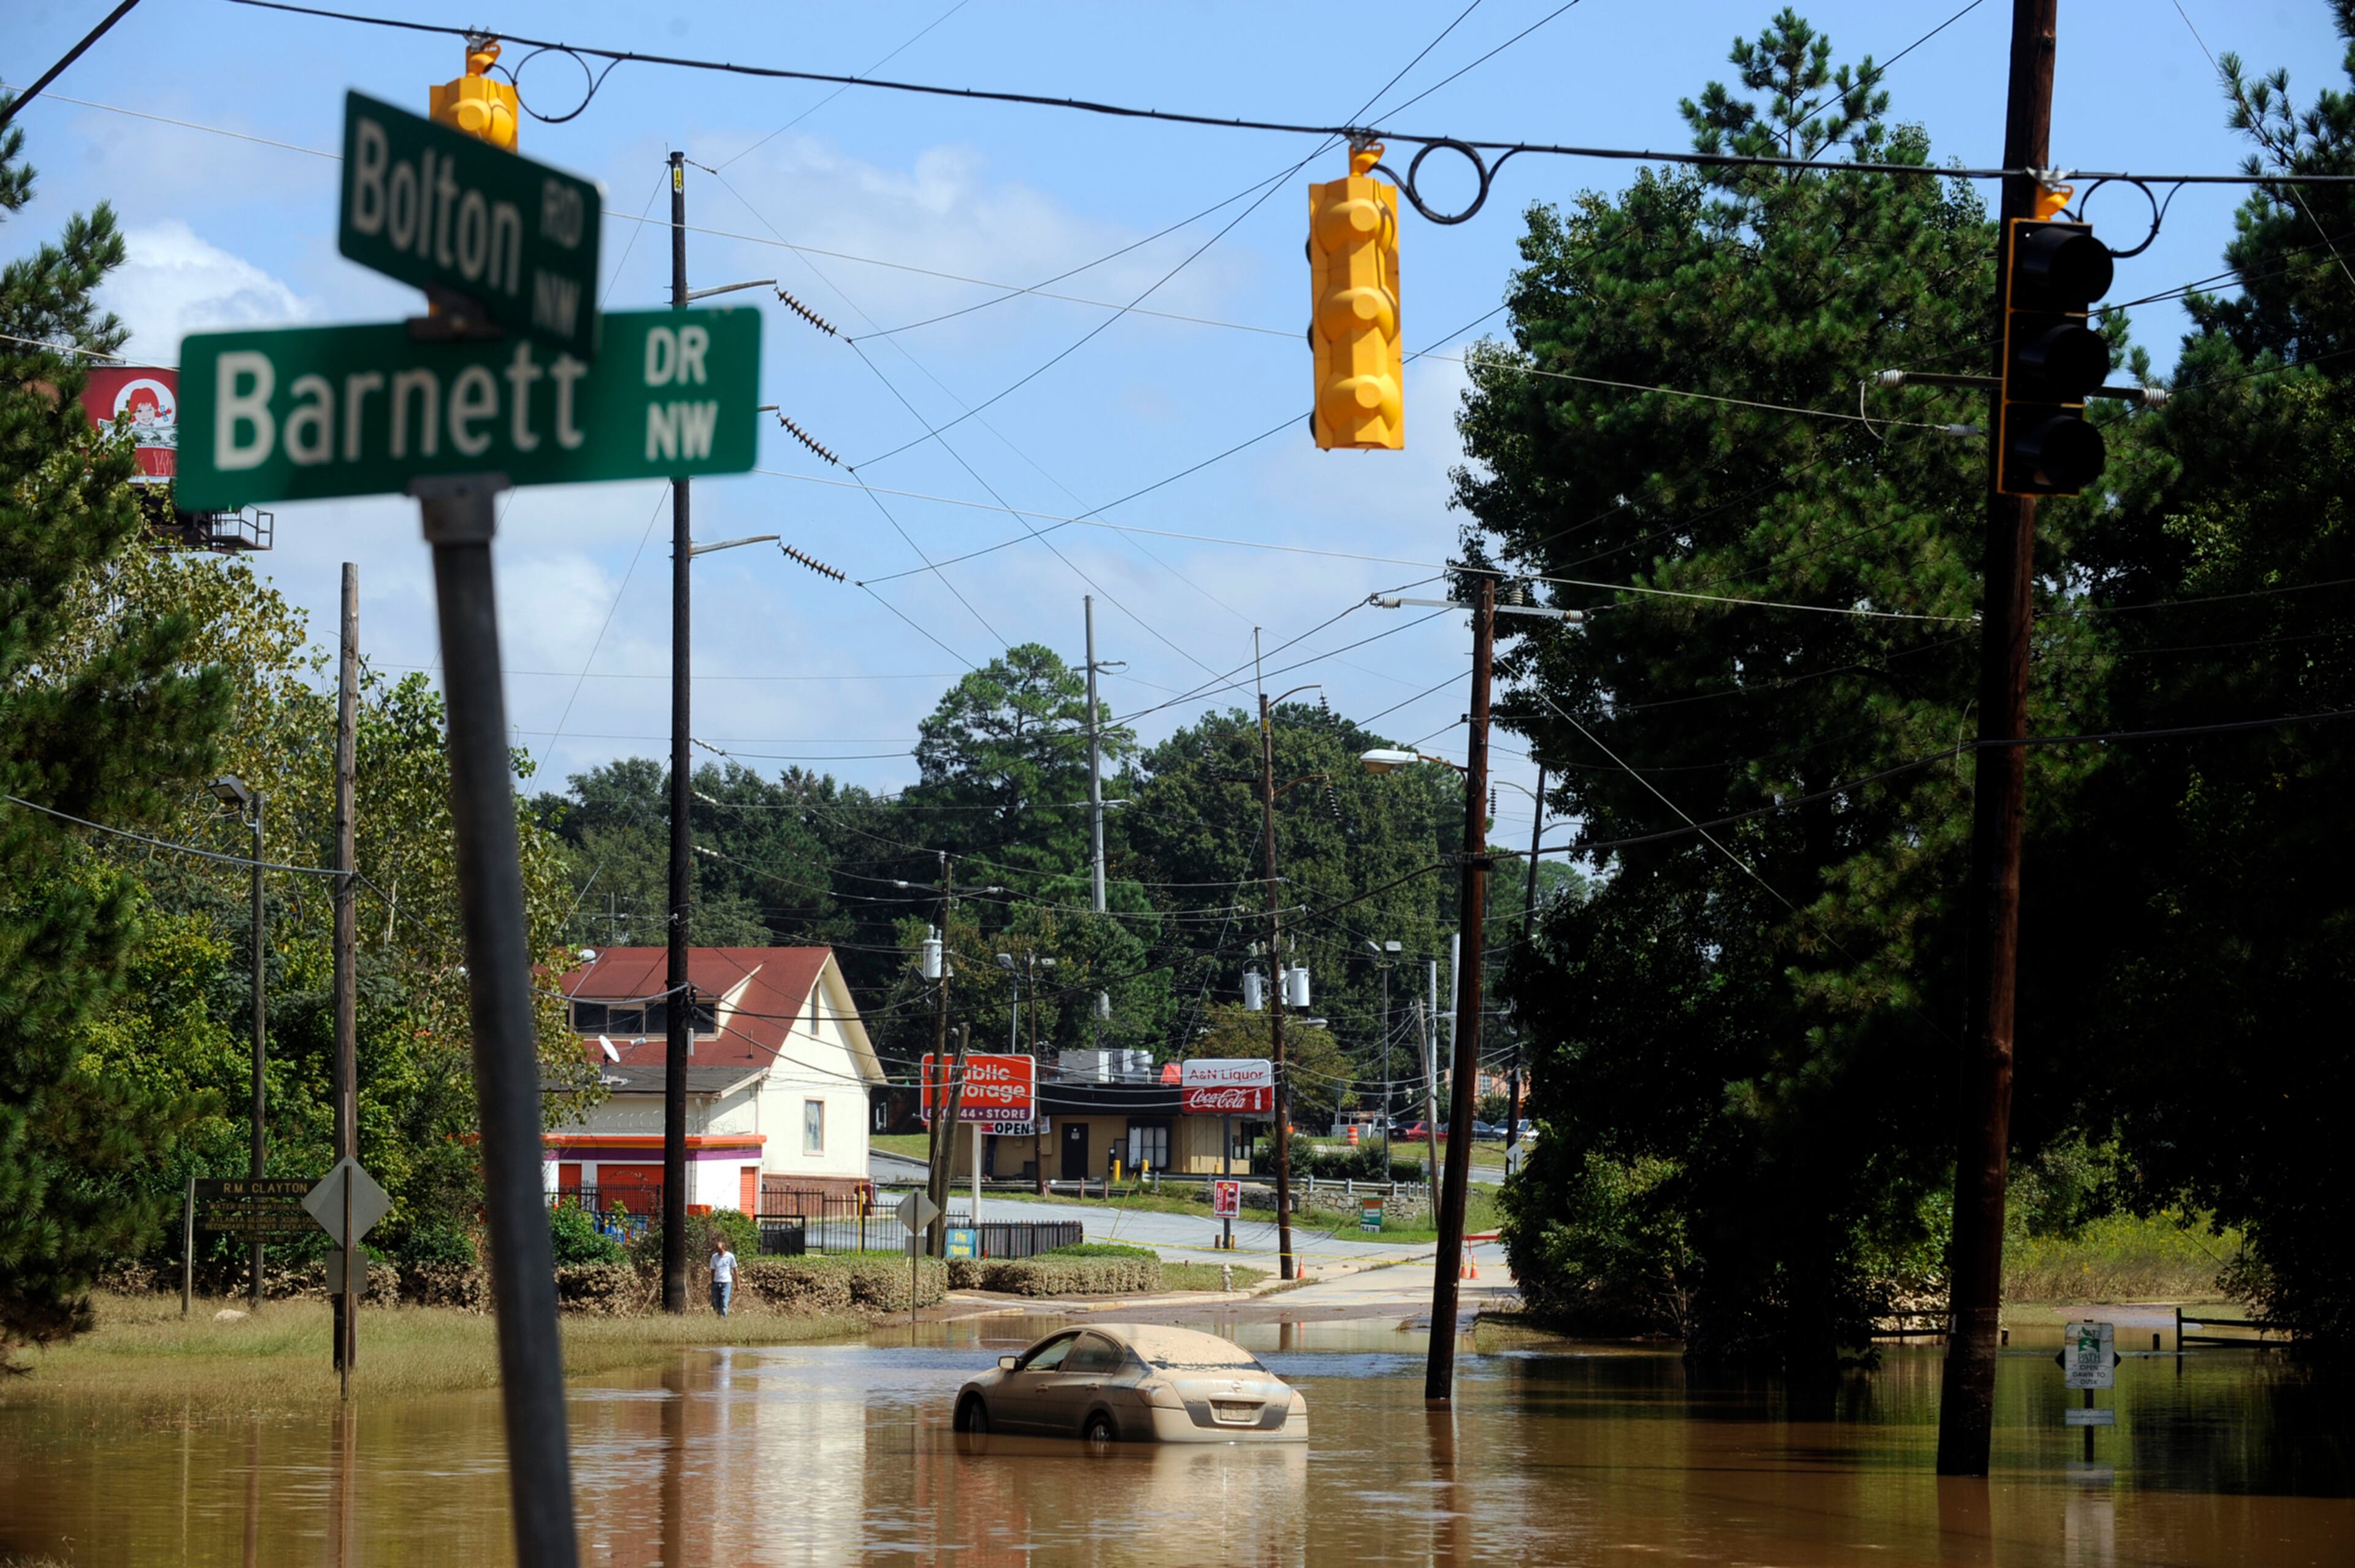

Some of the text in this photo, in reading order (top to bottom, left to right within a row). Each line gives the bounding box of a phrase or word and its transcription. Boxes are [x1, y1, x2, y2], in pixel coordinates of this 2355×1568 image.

[352, 117, 522, 297] Bolton
[540, 179, 583, 250] RD
[531, 269, 580, 340] NW
[645, 325, 709, 386] DR
[213, 341, 588, 471] Barnett
[646, 400, 719, 462] NW
[949, 1064, 1011, 1080] ublic
[1189, 1069, 1264, 1082] A&N Liquor
[1190, 1087, 1247, 1109] Coca-Cola
[986, 1109, 1026, 1119] STORE
[995, 1122, 1030, 1134] OPEN
[251, 1183, 308, 1193] CLAYTON
[2078, 1353, 2100, 1363] PATH
